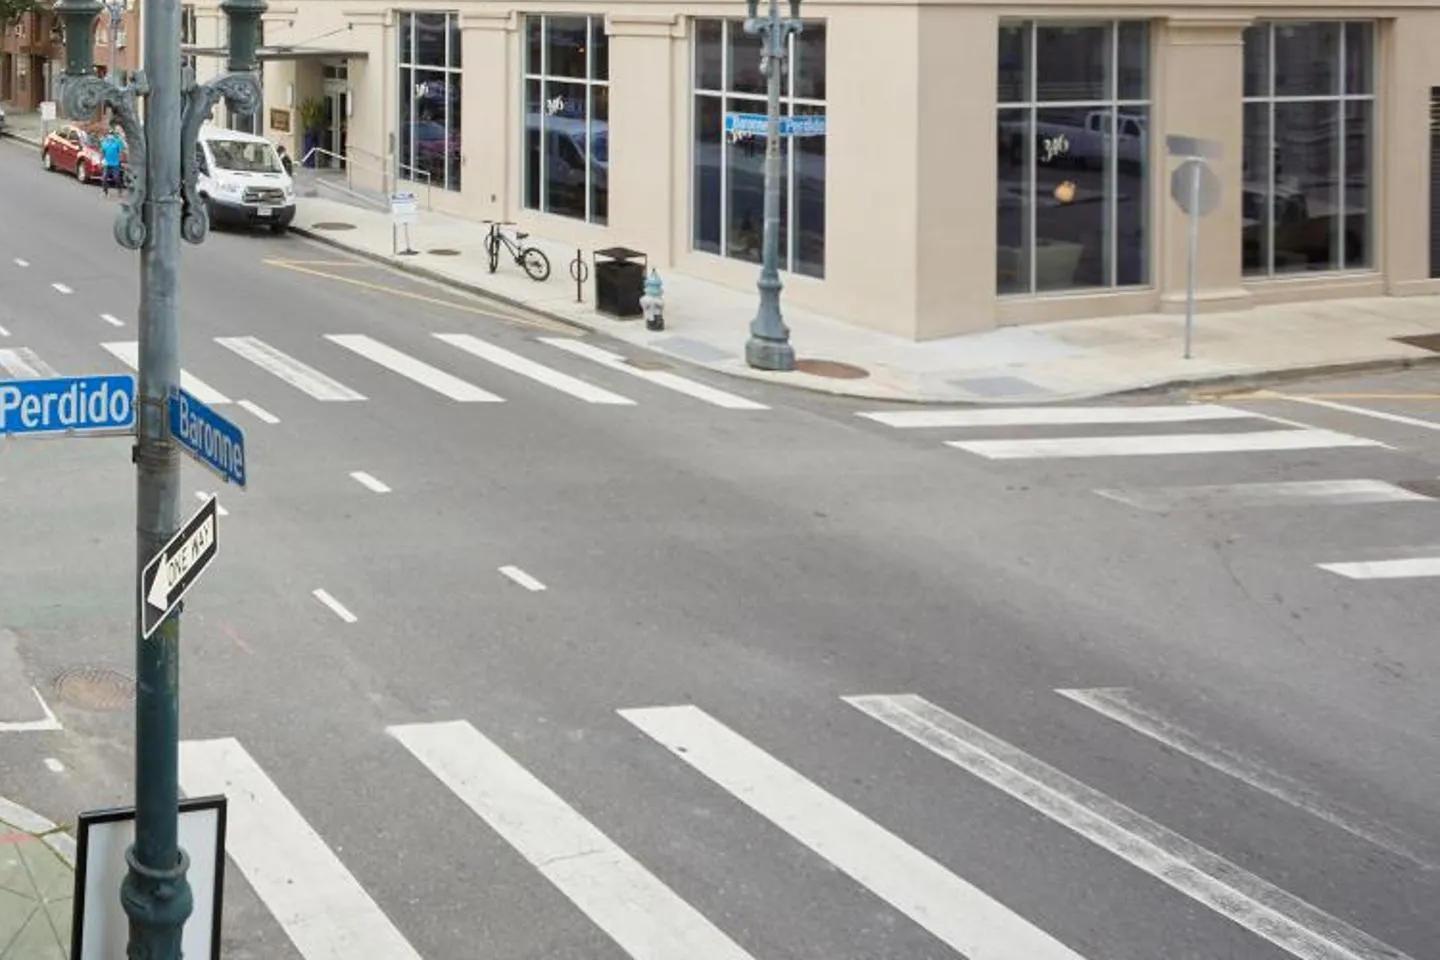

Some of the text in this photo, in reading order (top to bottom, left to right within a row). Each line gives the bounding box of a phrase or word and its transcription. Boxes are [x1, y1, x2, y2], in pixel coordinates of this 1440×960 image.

[179, 396, 243, 477] Baronne
[167, 522, 211, 586] ONE WAY
